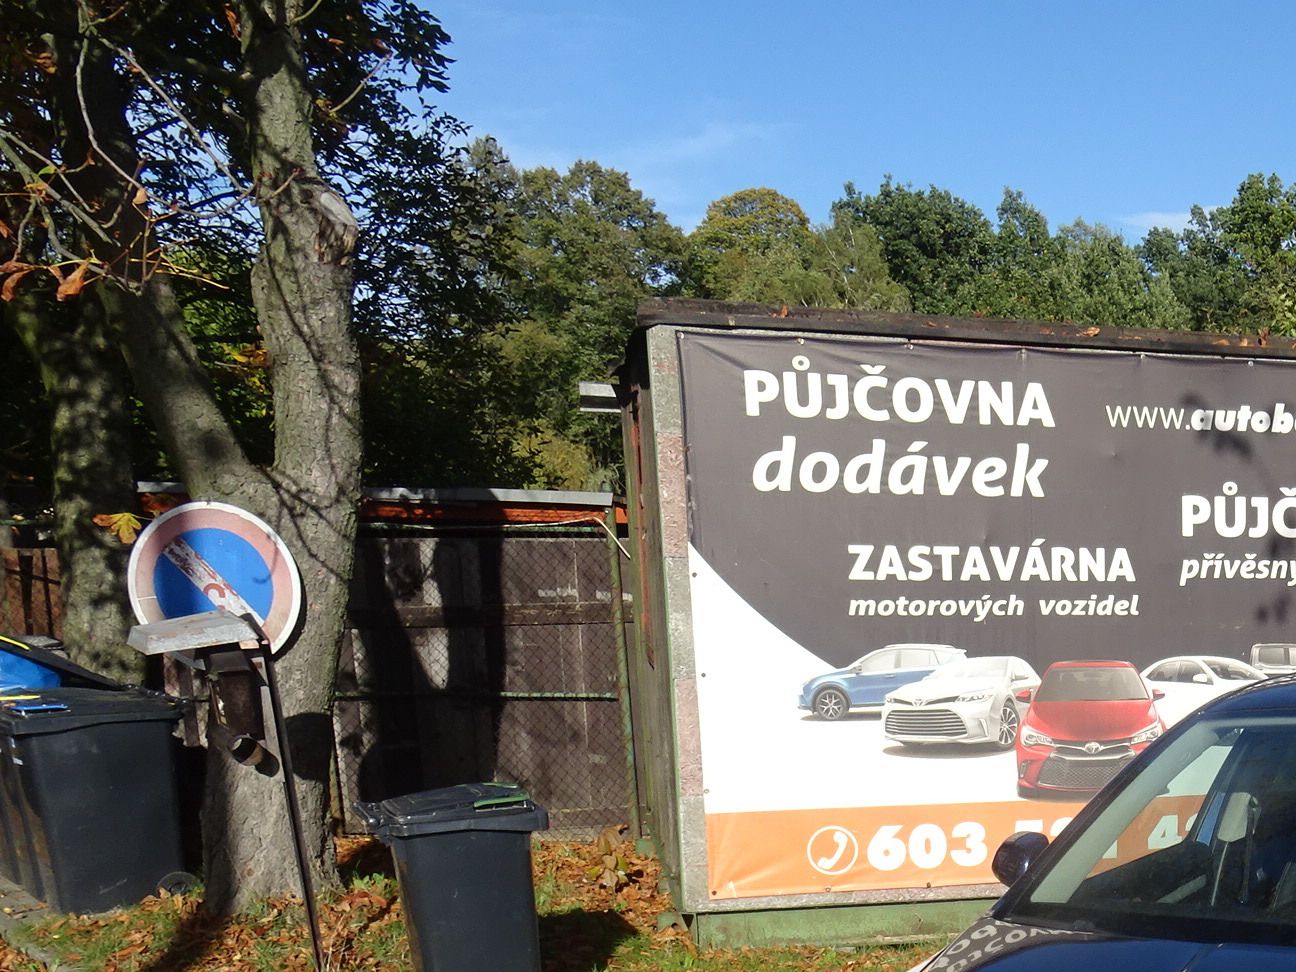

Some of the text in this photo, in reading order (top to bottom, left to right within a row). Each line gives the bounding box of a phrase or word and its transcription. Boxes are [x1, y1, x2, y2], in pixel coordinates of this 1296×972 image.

[743, 355, 1056, 428] PŮJČOVNA
[752, 435, 1050, 498] dodávek
[847, 538, 1137, 582] ZASTAVÁRNA
[847, 595, 1140, 622] motorových vozidel
[867, 821, 988, 872] 603
